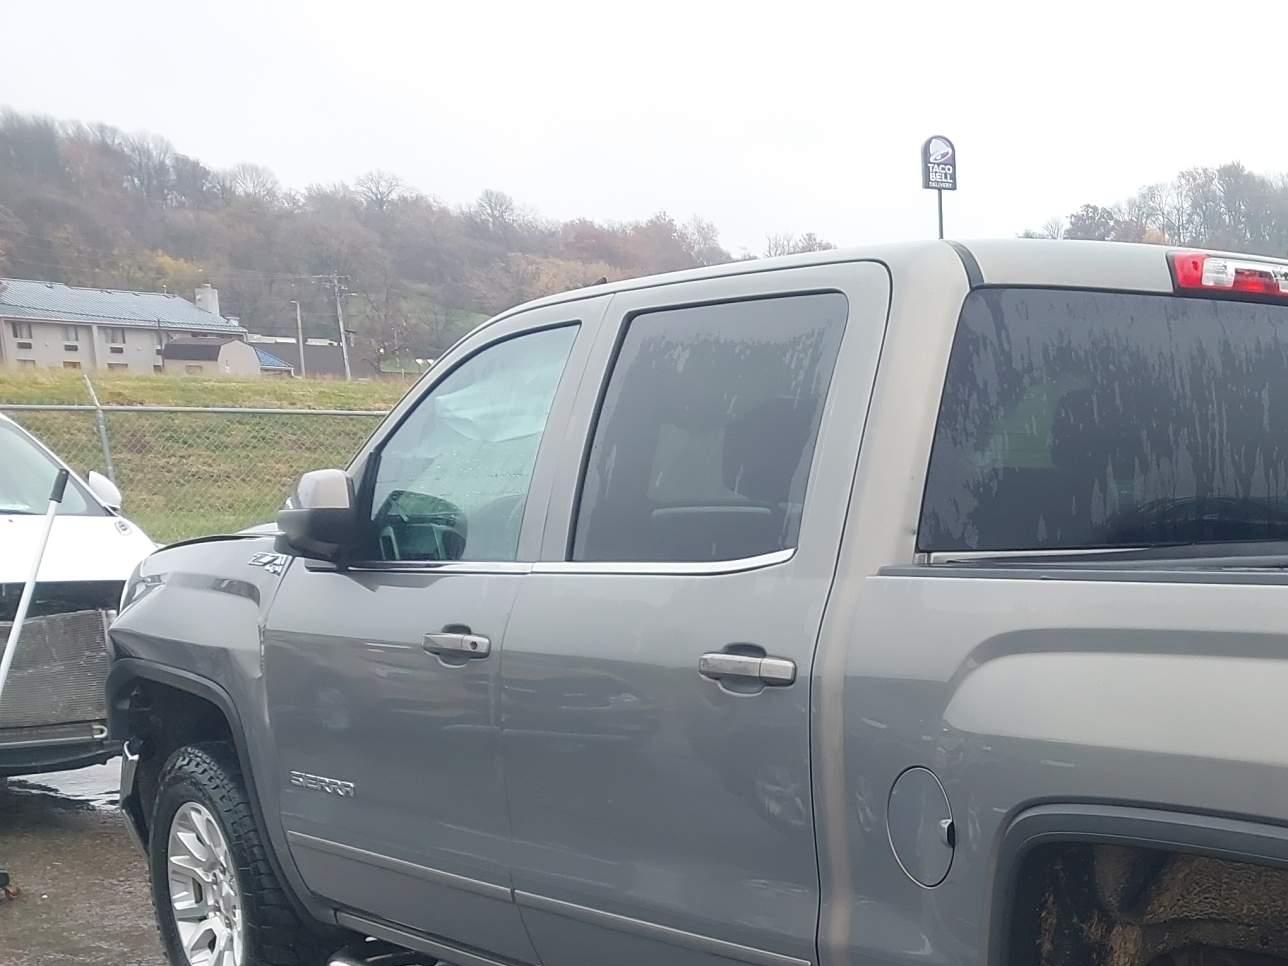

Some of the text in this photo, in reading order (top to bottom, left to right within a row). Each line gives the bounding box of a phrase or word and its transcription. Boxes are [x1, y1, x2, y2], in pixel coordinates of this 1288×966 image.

[928, 164, 952, 173] TACO
[930, 173, 952, 182] BELL
[288, 769, 355, 798] SIERRA
